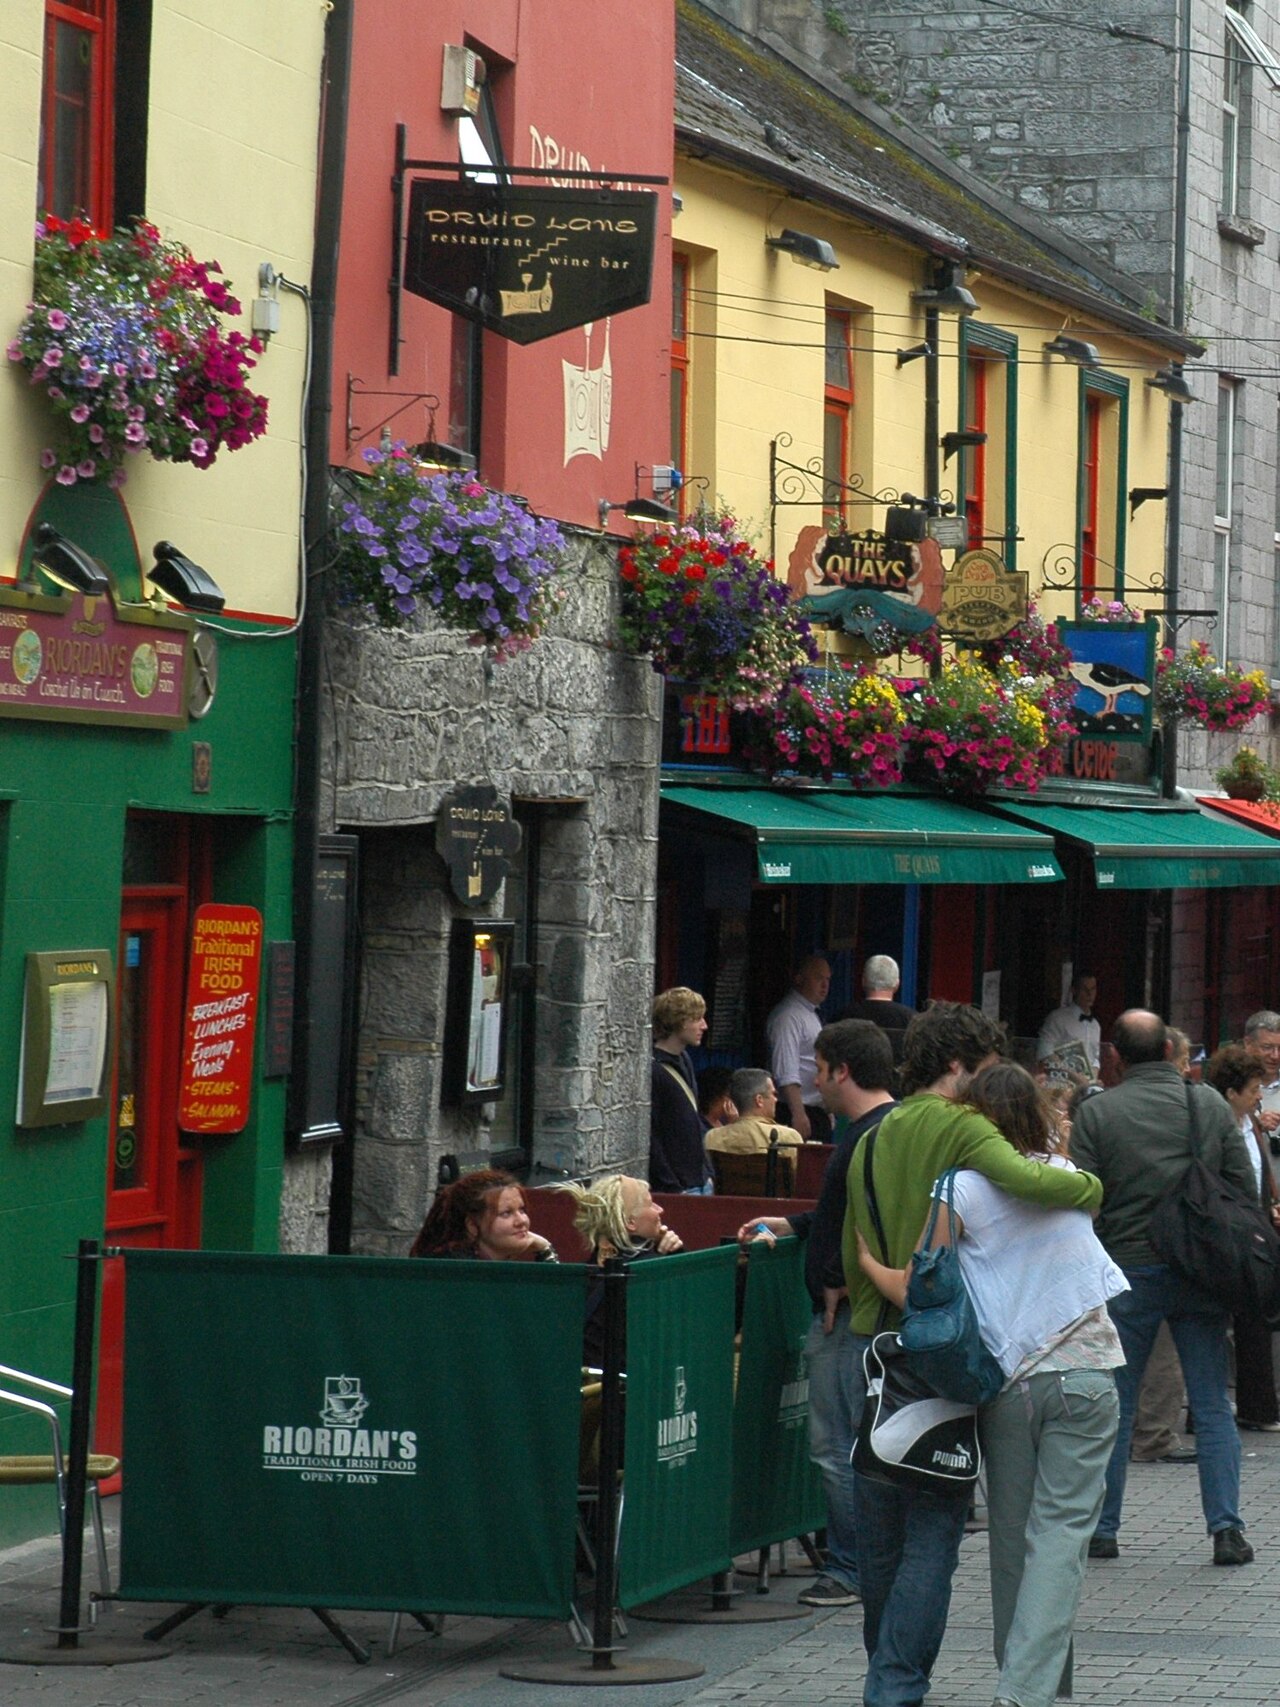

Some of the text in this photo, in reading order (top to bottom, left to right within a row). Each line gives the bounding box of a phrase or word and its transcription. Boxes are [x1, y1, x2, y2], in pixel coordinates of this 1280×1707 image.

[431, 233, 533, 248] restaurant
[550, 256, 630, 270] wine bar
[851, 539, 886, 558] THE
[826, 555, 906, 588] QUAYS
[953, 586, 1006, 605] PUB
[46, 637, 128, 678] RIORDAN'S
[197, 919, 260, 936] RIORDAN'S
[194, 936, 256, 957] Traditional
[204, 957, 243, 974] IRISH
[201, 974, 243, 990] FOOD
[192, 992, 251, 1021] BREAKFAST
[194, 1014, 247, 1040] LUNCHES
[191, 1040, 235, 1062] Evening
[190, 1081, 236, 1096] STEAKS
[187, 1102, 238, 1118] SALMON
[263, 1425, 418, 1460] RIORDAN'S
[262, 1455, 417, 1471] TRADITIONAL IRISH FOOD
[932, 1450, 967, 1468] PUMA
[301, 1472, 378, 1485] OPEN 7 DAYS
